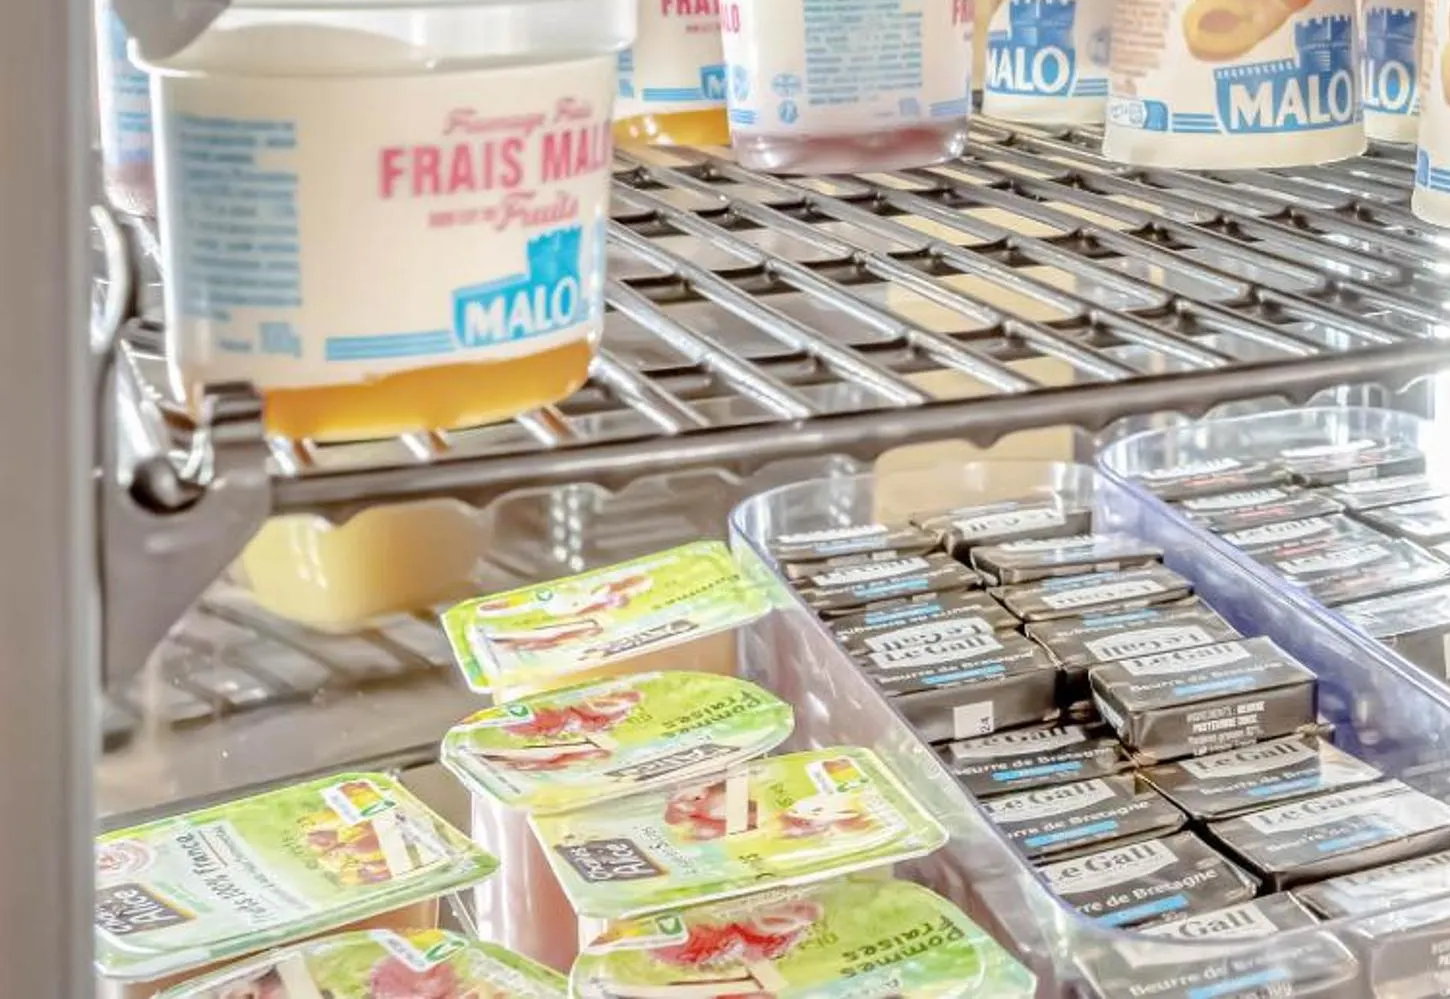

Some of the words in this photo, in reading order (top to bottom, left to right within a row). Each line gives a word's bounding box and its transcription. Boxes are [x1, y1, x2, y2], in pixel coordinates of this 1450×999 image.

[1230, 71, 1353, 132] MALO
[379, 135, 525, 199] FRAIS
[464, 275, 579, 347] MALO
[1194, 752, 1235, 773] Le
[1237, 742, 1300, 764] Gall
[1030, 780, 1098, 806] Gall
[1042, 819, 1066, 833] de
[1257, 807, 1301, 827] Le
[1082, 841, 1157, 874] Gall
[1105, 893, 1130, 907] de
[1133, 867, 1218, 900] Bretagne
[841, 913, 955, 962] Fraises
[1177, 908, 1256, 939] Gall
[1128, 973, 1196, 998] Beurre
